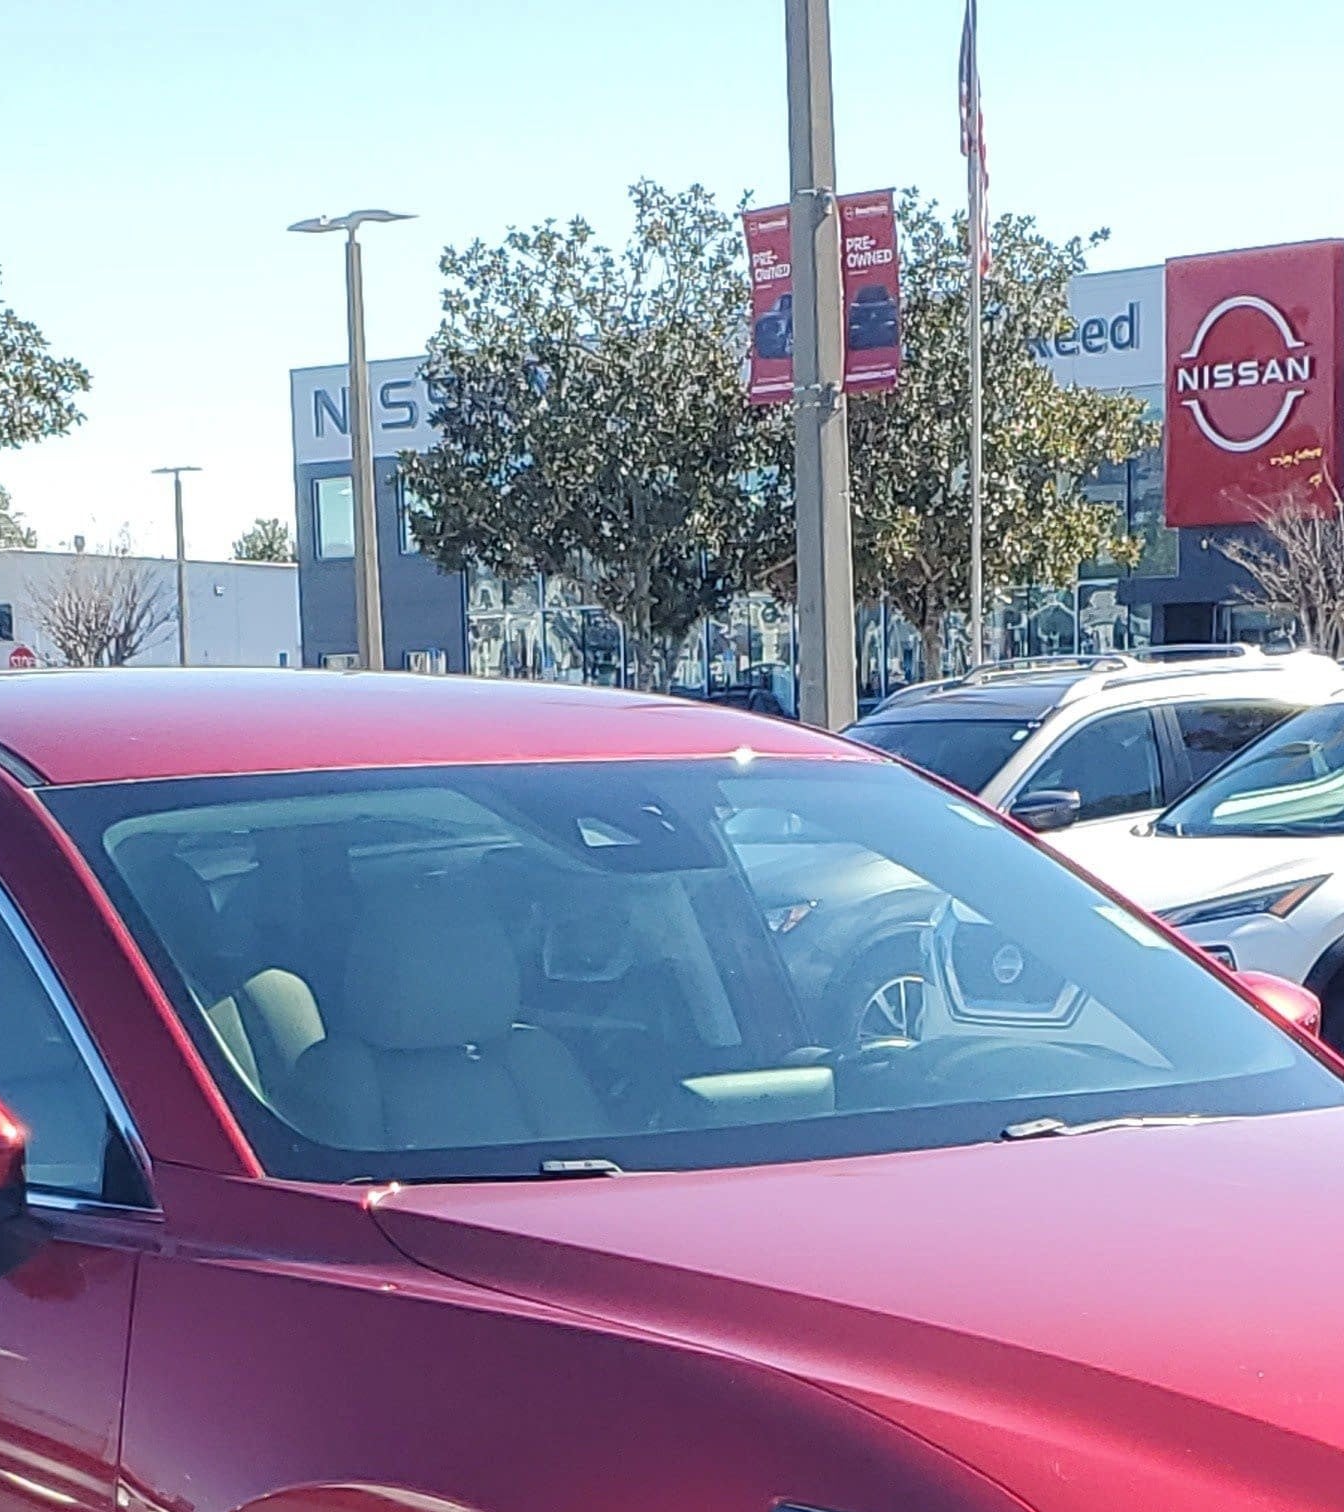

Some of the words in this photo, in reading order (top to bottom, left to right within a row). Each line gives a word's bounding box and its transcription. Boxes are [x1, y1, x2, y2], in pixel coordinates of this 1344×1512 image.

[846, 236, 876, 252] PRE-
[847, 249, 892, 268] OWNED
[755, 264, 791, 282] OWNED
[1177, 355, 1311, 393] NISSAN
